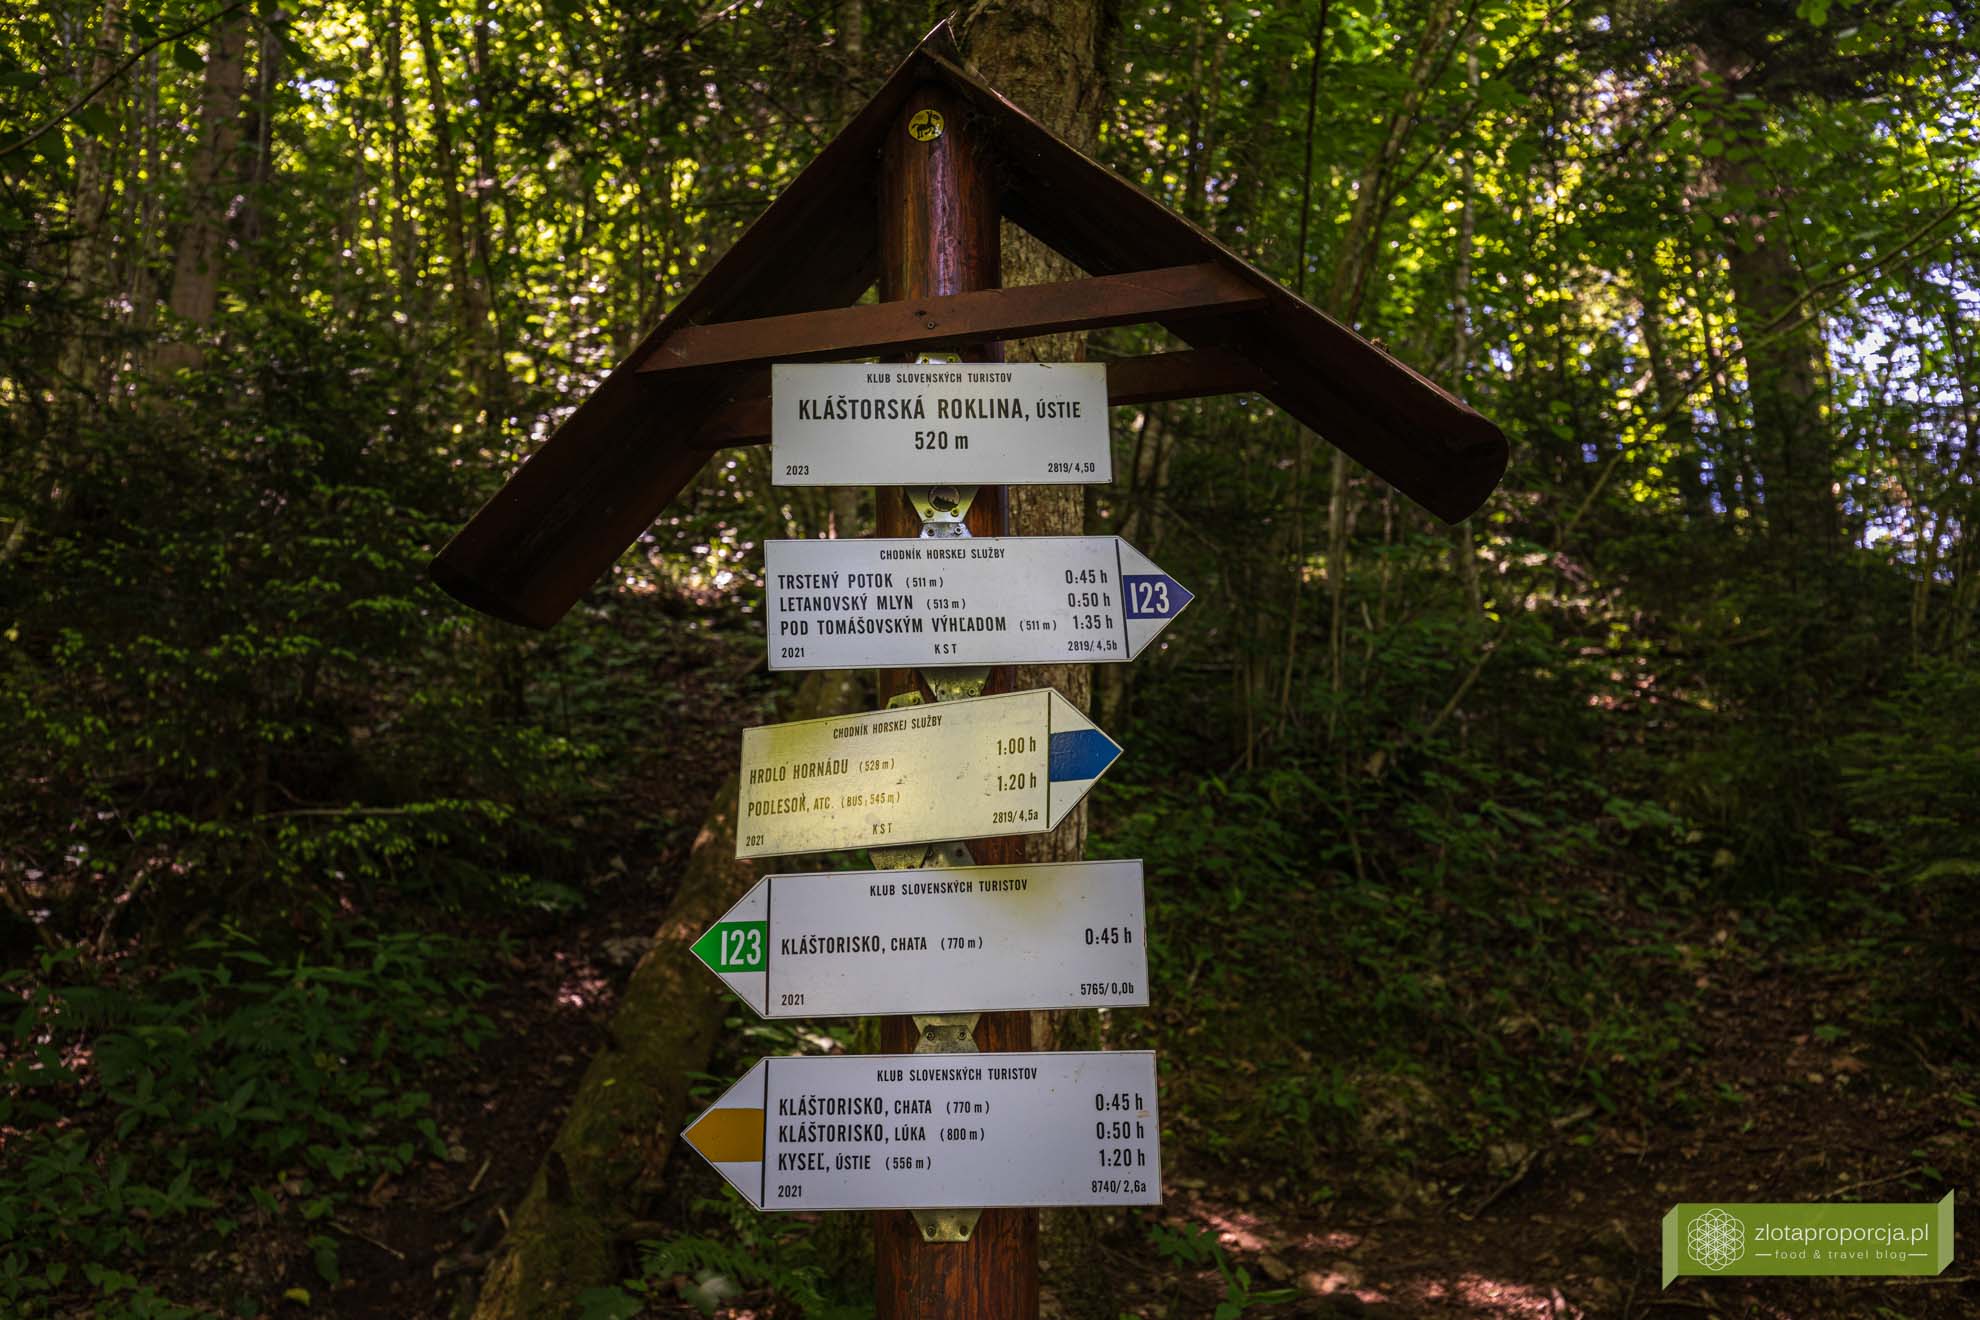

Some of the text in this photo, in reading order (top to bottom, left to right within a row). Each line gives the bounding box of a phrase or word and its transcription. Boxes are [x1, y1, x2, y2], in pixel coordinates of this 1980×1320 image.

[867, 371, 1012, 384] KLUB SLOVENSKÝCH TURISTOV
[799, 395, 1081, 422] KLÁŠTORSKÁ ROKLINA, ÚSTIE
[915, 431, 969, 450] 520 m
[786, 465, 809, 476] 2023
[880, 546, 1005, 560] CHODNÍK HORSKEJ SLUŽBY
[778, 571, 839, 590] TRSTENÝ
[848, 573, 893, 588] POTOK
[1065, 570, 1096, 584] 0:45
[1101, 569, 1108, 583] h
[780, 593, 868, 612] LETANOVSKÝ
[877, 595, 913, 610] MLYN
[1068, 593, 1099, 607] 0:50
[1103, 592, 1111, 607] h
[1130, 581, 1170, 614] 123
[781, 620, 809, 636] POD
[817, 616, 923, 635] TOMÁŠOVSKÝM
[932, 615, 1006, 632] VÝHĽADOM
[1073, 615, 1101, 630] 1:35
[1105, 614, 1113, 629] h
[781, 647, 805, 658] 2021
[833, 715, 942, 739] CHODNÍK HORSKEJ SLUŽBY
[750, 766, 786, 785] HRDLO
[793, 757, 849, 780] HORNÁDU
[997, 737, 1025, 756] 1:00
[1029, 736, 1036, 752] h
[870, 793, 886, 805] 545
[997, 773, 1025, 792] 1:20
[1030, 772, 1037, 788] h
[746, 834, 764, 847] 2021
[870, 879, 1028, 896] KLUB SLOVENSKÝCH TURISTOV
[720, 929, 761, 966] 123
[782, 935, 886, 955] KLÁŠTORISKO,
[891, 937, 927, 951] CHATA
[1085, 928, 1119, 945] 0:45
[1124, 927, 1132, 943] h
[782, 994, 804, 1006] 2021
[877, 1067, 1037, 1082] KLUB SLOVENSKÝCH TURISTOV
[779, 1095, 889, 1117] KLÁŠTORISKO,
[894, 1100, 932, 1114] CHATA
[1095, 1093, 1130, 1111] 0:45
[1135, 1093, 1143, 1110] h
[779, 1121, 889, 1144] KLÁŠTORISKO,
[895, 1124, 926, 1141] LÚKA
[1096, 1122, 1131, 1139] 0:50
[1137, 1122, 1144, 1139] h
[778, 1152, 830, 1173] KYSEĽ,
[836, 1153, 871, 1170] ÚSTIE
[1099, 1149, 1132, 1166] 1:20
[1137, 1149, 1145, 1166] h
[778, 1185, 802, 1197] 2021
